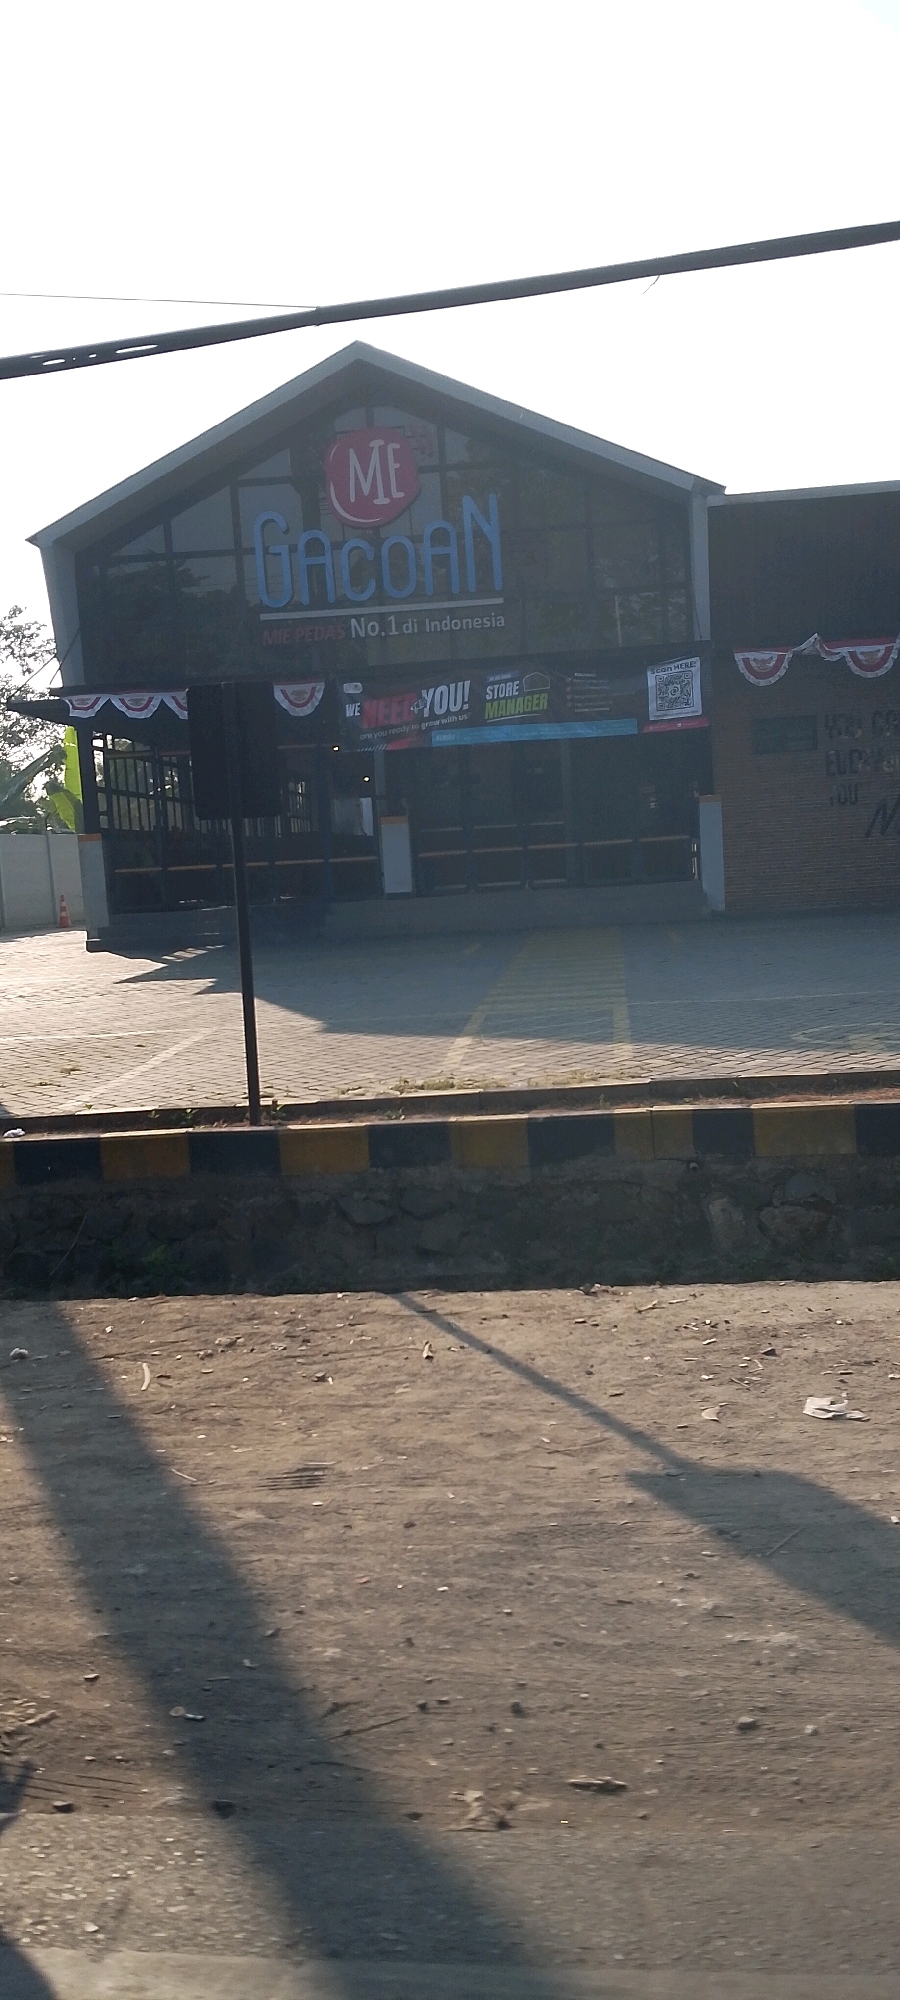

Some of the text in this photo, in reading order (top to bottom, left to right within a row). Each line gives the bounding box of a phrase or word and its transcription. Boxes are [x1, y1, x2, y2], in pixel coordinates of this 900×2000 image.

[349, 439, 405, 505] MIE
[253, 493, 503, 608] GACOAN
[262, 612, 506, 646] MIE PEDAS No.1 di Indonesia
[345, 702, 361, 717] WE
[421, 680, 471, 718] YOU!
[484, 692, 549, 720] MANAGER
[485, 680, 520, 700] STORE
[373, 729, 388, 739] you
[388, 724, 411, 736] ready
[411, 722, 420, 730] to
[440, 714, 458, 725] with
